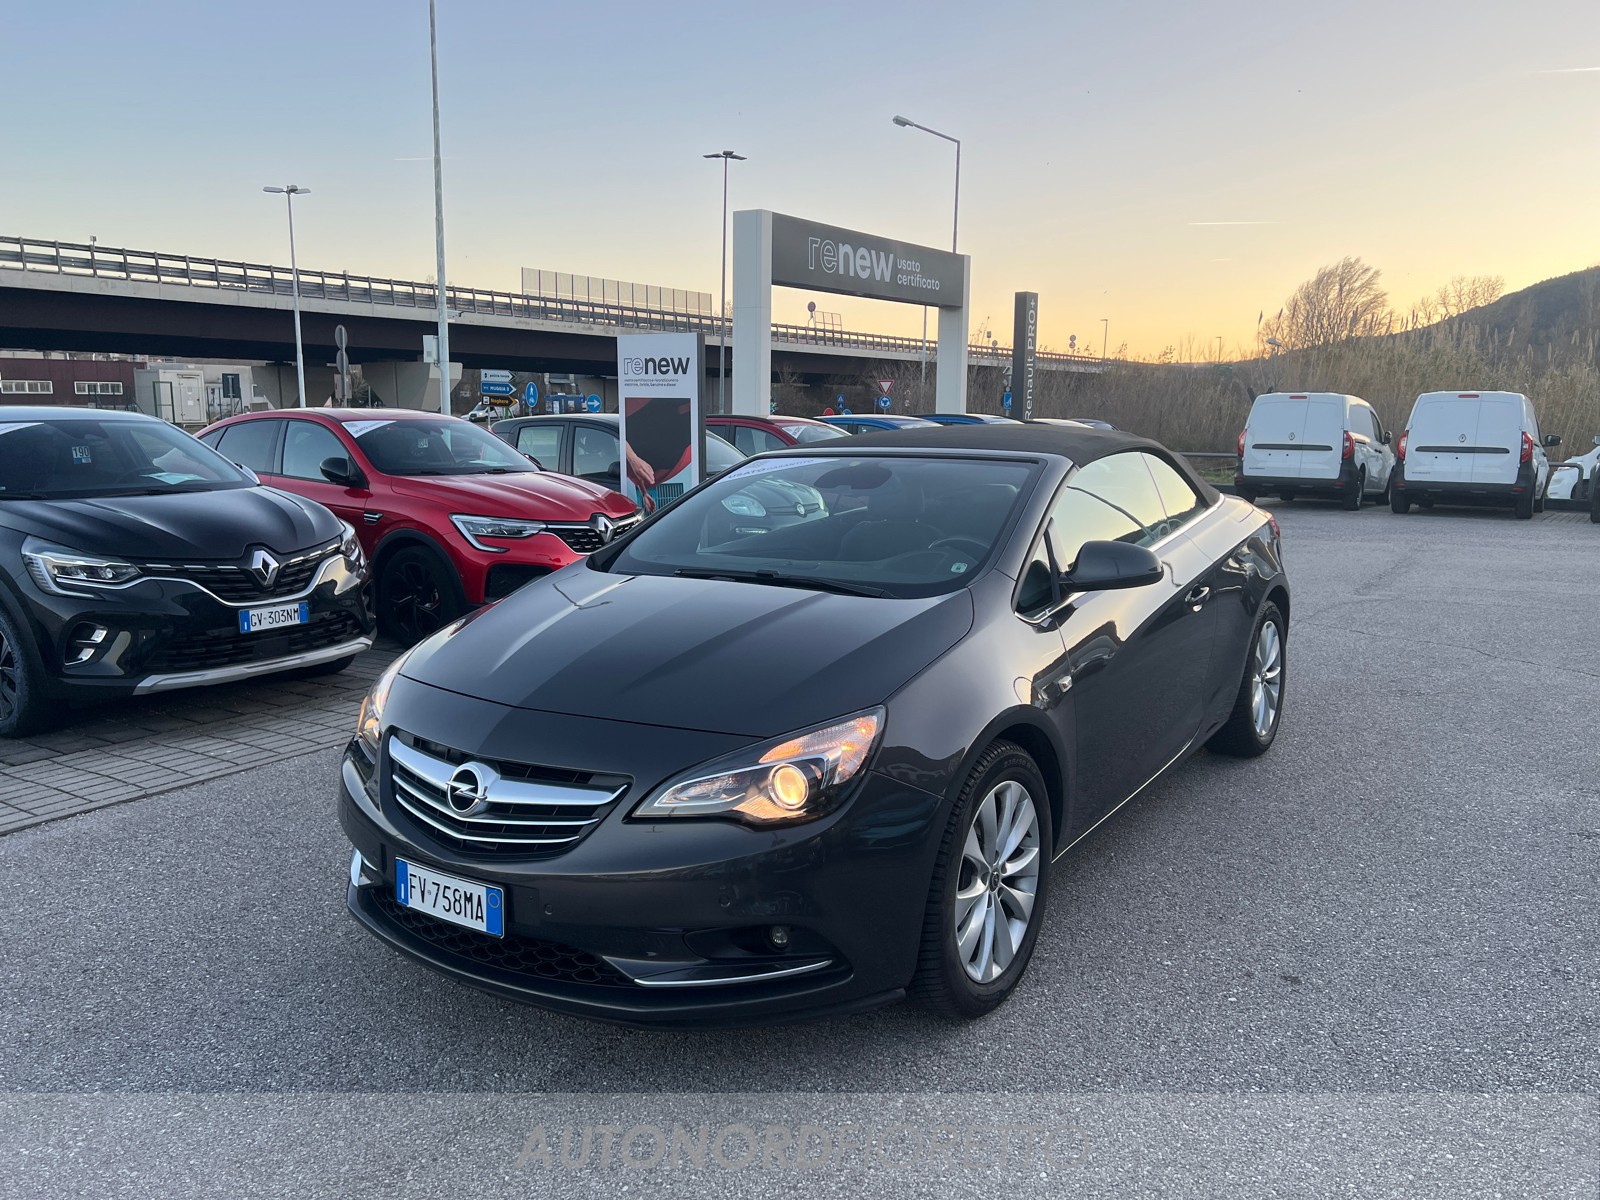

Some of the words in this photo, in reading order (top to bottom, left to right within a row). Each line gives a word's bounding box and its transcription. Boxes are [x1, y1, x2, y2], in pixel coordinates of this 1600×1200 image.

[808, 237, 894, 283] renew
[897, 258, 921, 272] usato
[897, 272, 940, 291] certificato
[1027, 298, 1036, 350] PRO+
[624, 357, 690, 375] renew
[1024, 355, 1034, 420] Renault
[72, 446, 89, 457] 190
